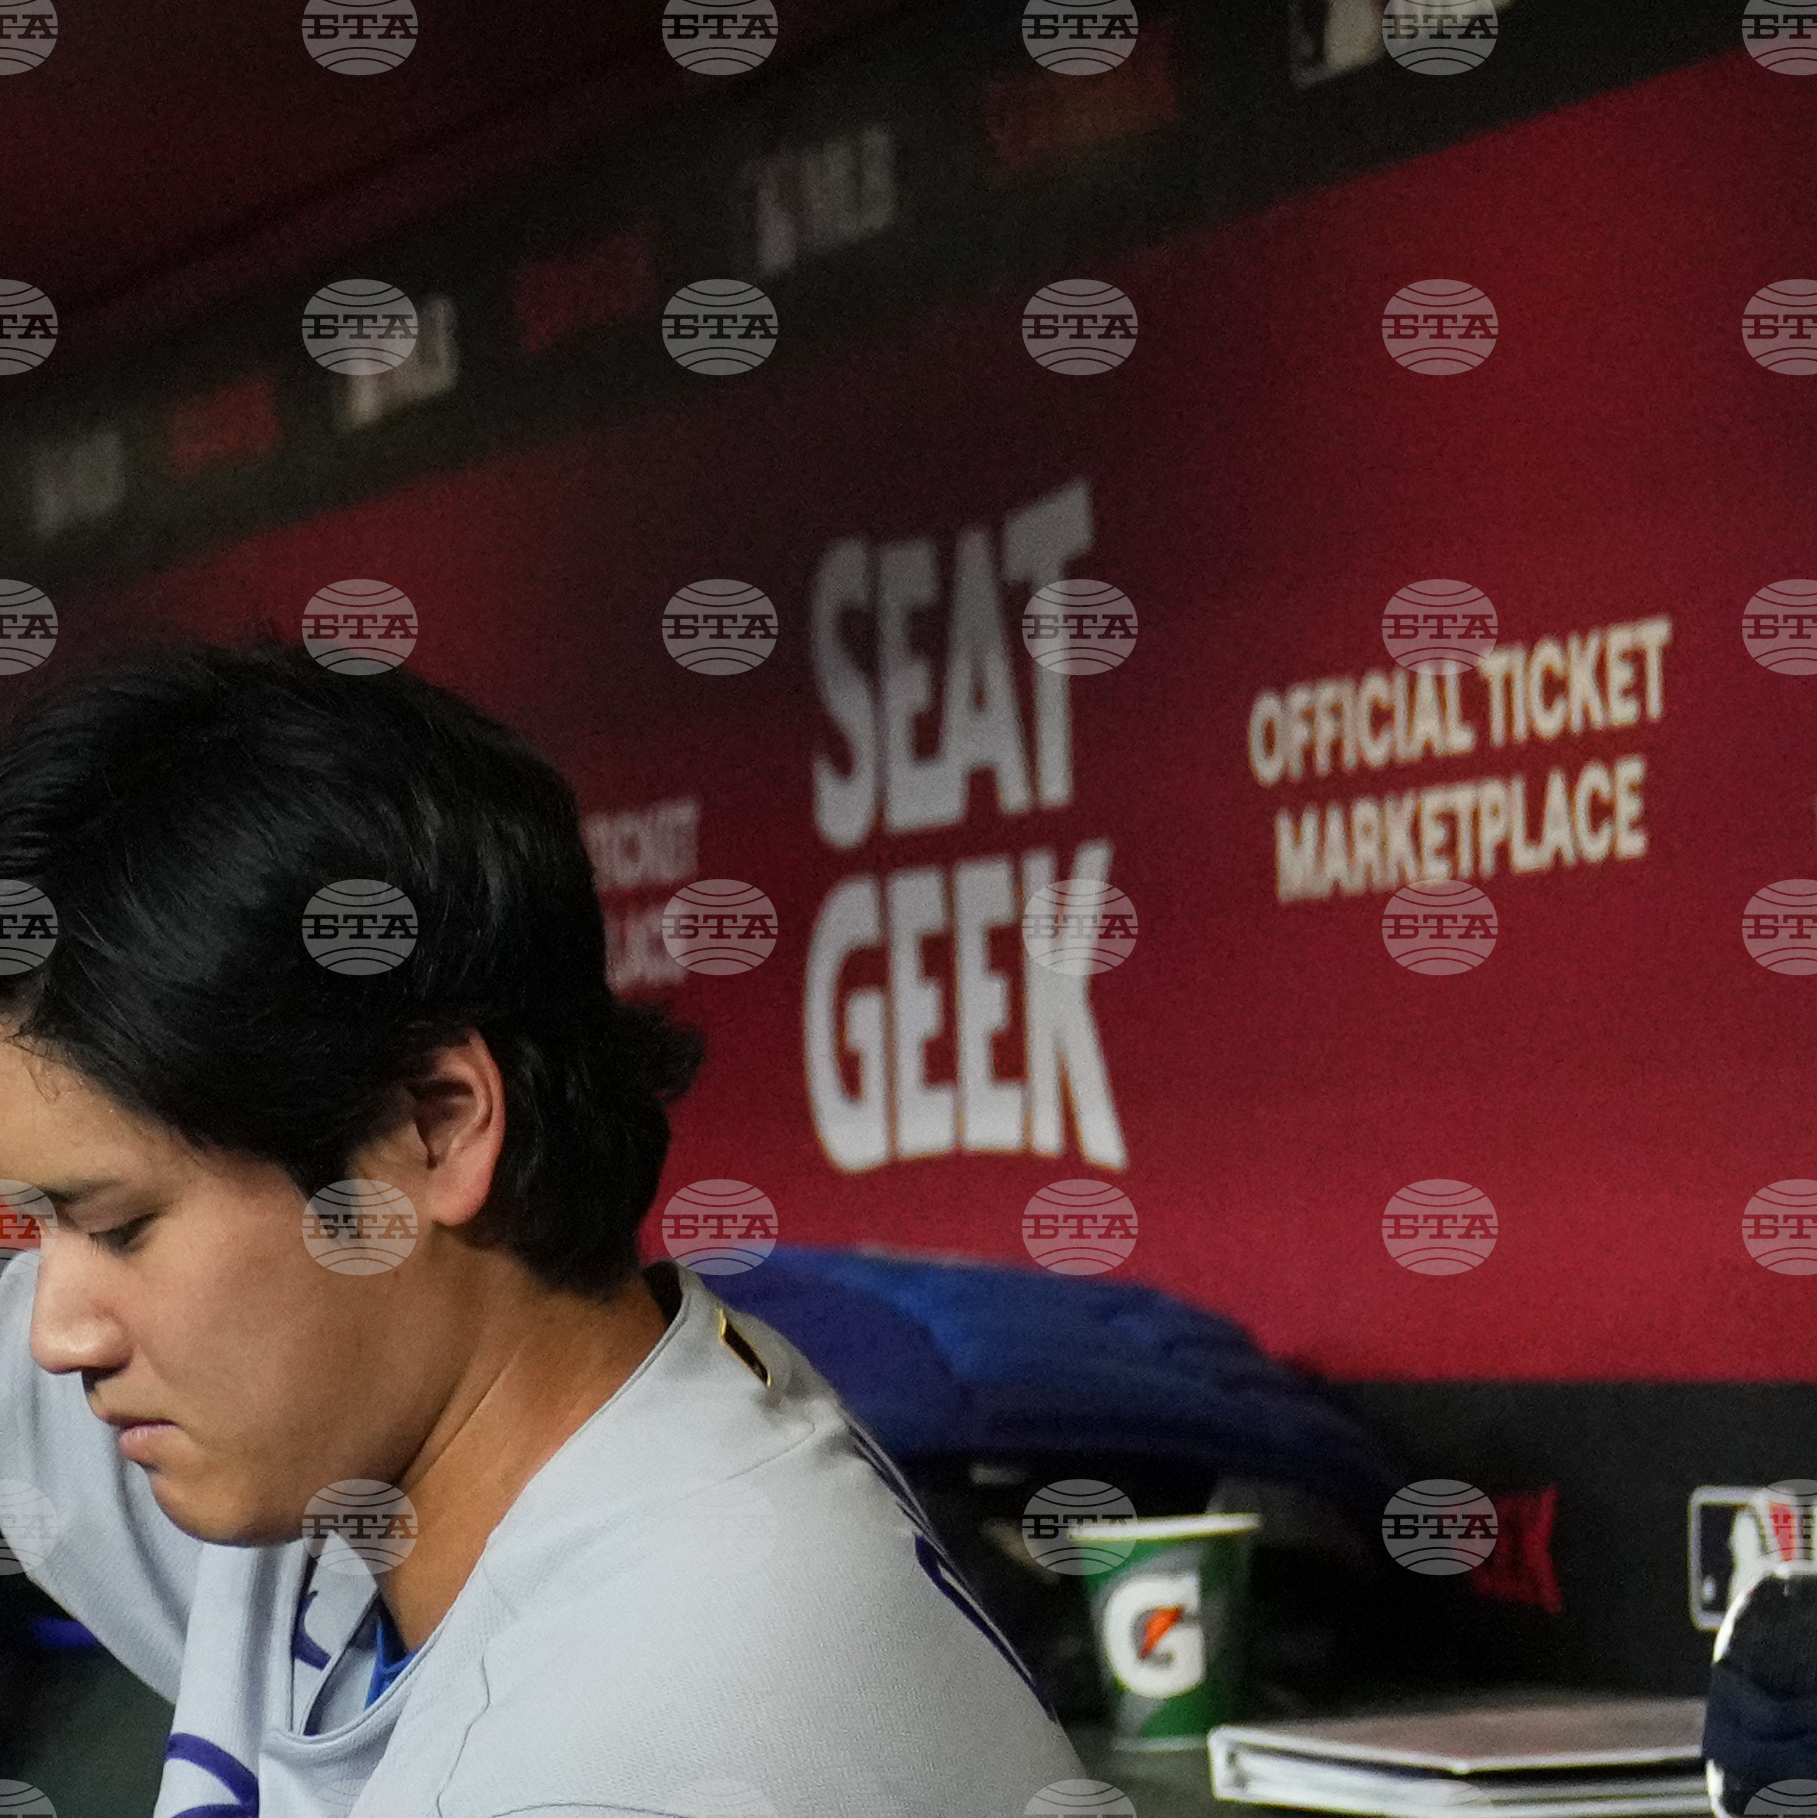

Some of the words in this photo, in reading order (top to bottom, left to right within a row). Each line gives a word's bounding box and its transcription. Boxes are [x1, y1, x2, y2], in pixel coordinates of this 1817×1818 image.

[811, 478, 1094, 850] SEAT
[1248, 660, 1476, 788] OFFICIAL
[1479, 613, 1671, 748] TICKET
[1275, 754, 1649, 905] MARKETPLACE
[803, 838, 1129, 1174] GEEK
[1103, 1571, 1208, 1700] G
